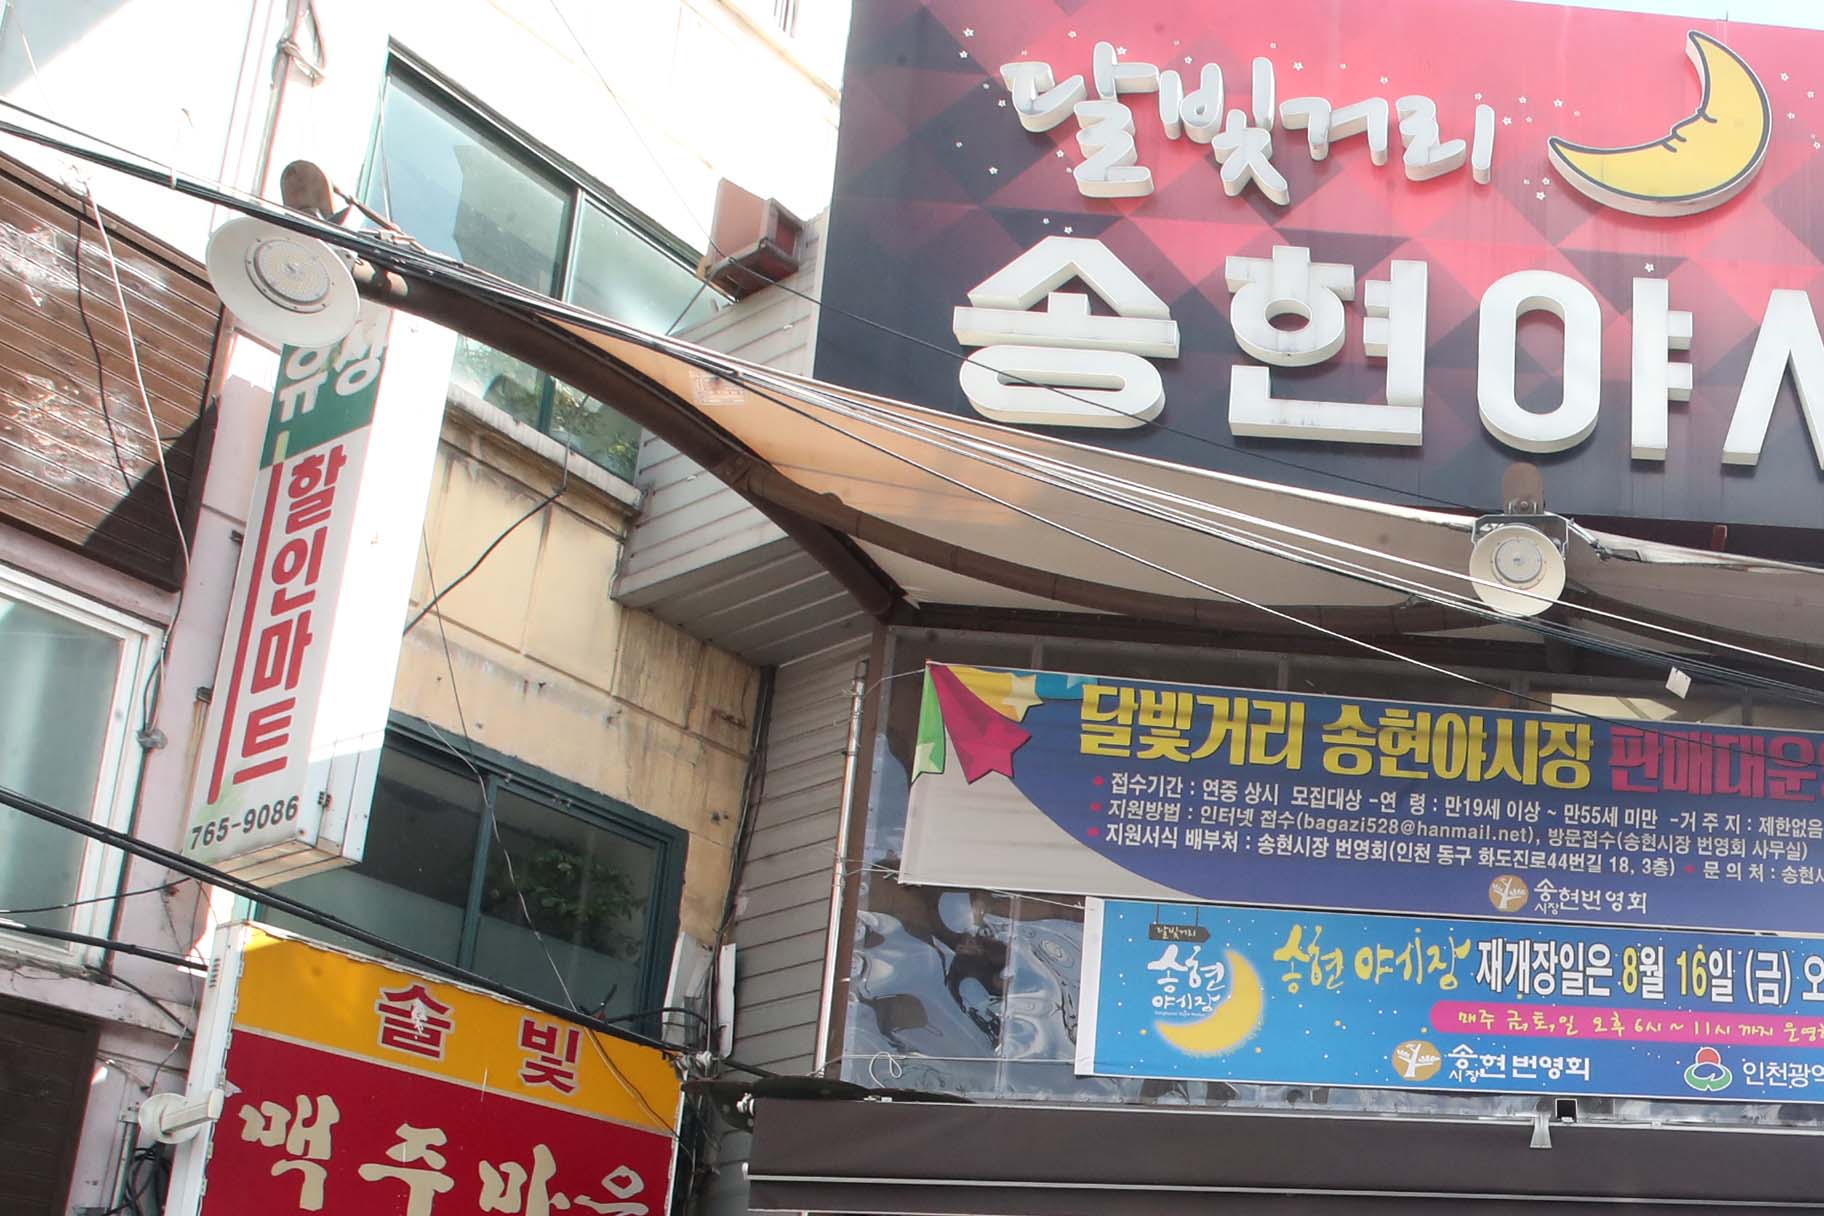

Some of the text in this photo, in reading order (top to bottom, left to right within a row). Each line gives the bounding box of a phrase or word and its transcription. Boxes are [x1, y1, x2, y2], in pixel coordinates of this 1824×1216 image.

[1000, 41, 1495, 204] 달빛거리
[233, 445, 346, 785] 할인마트
[1080, 684, 1305, 770] 달빛거리
[1322, 704, 1594, 789] 송현야시장
[190, 795, 299, 851] 765-9086
[1108, 798, 1181, 822] 지원방법
[1200, 805, 1253, 827] 인터넷
[1697, 836, 1746, 858] 번영회
[1752, 839, 1808, 861] 사무실)
[1111, 772, 1183, 798] 접수기간
[1203, 779, 1237, 802] 연중
[1245, 782, 1279, 805] 상시
[1291, 784, 1362, 811] 모집대상
[1444, 795, 1500, 820] 만19세
[1507, 800, 1540, 822] 이상
[1564, 803, 1618, 828] 만55세
[1625, 808, 1658, 829] 미만
[1758, 816, 1824, 839] 제한없음
[1105, 822, 1179, 848] 지원서식
[1184, 828, 1239, 853] 배부처
[1257, 833, 1330, 858] 송현시장
[1436, 845, 1472, 866] 동구
[1478, 846, 1602, 873] 화도진로44번길
[1641, 856, 1676, 877] 3층)
[1146, 943, 1226, 993] 송현
[1273, 924, 1345, 993] 송현
[1354, 928, 1473, 991] 야시장
[1475, 937, 1614, 997] 재개장일은
[1622, 945, 1665, 1000] 8월
[1675, 948, 1735, 1003] 16일
[1744, 948, 1793, 1006] (금)
[1151, 993, 1221, 1012] 야시장
[1458, 1009, 1495, 1030] 매주
[1592, 1013, 1625, 1037] 오후
[1633, 1015, 1663, 1034] 6시
[1694, 1019, 1731, 1037] 11시
[1739, 1022, 1775, 1038] 까지
